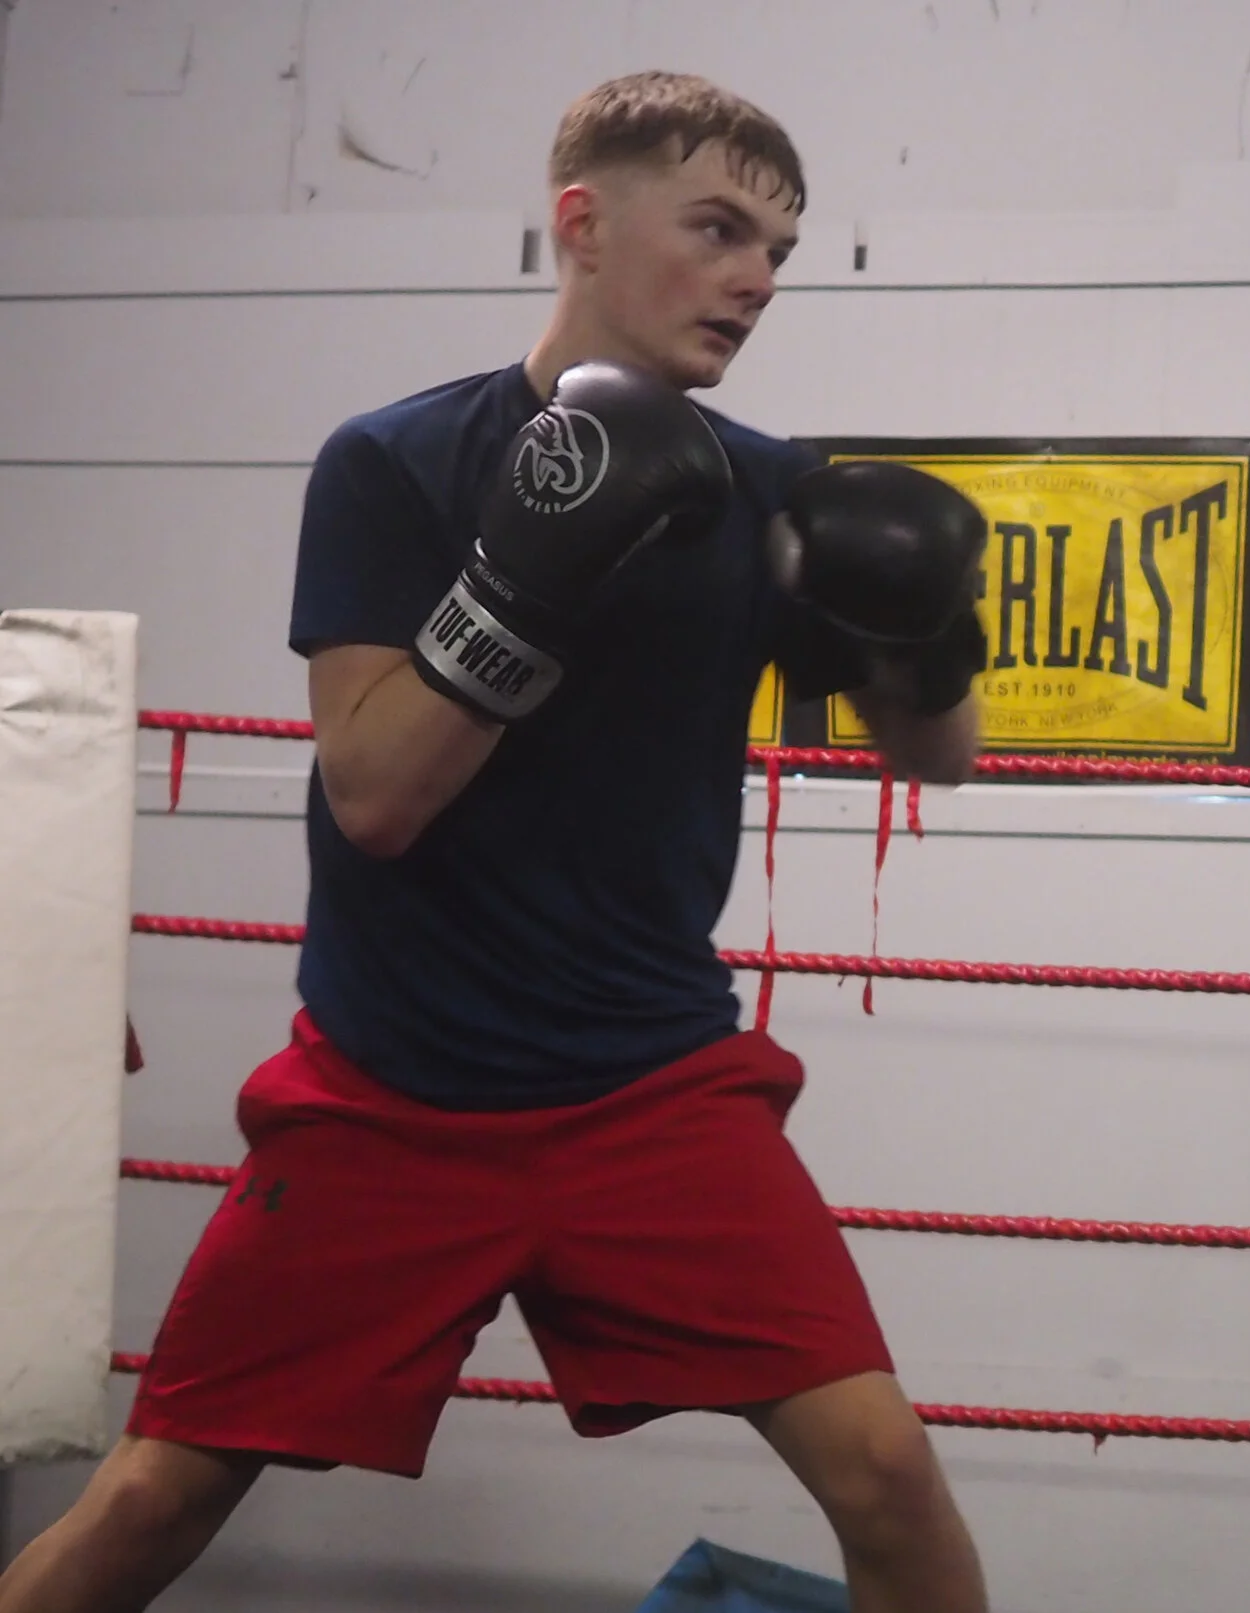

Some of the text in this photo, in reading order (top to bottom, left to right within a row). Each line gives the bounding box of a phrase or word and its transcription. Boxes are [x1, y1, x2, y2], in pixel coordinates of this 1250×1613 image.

[960, 474, 1125, 501] OXING EQUIPMENT
[972, 480, 1228, 712] RLAST
[430, 597, 536, 697] TUF-WEAR
